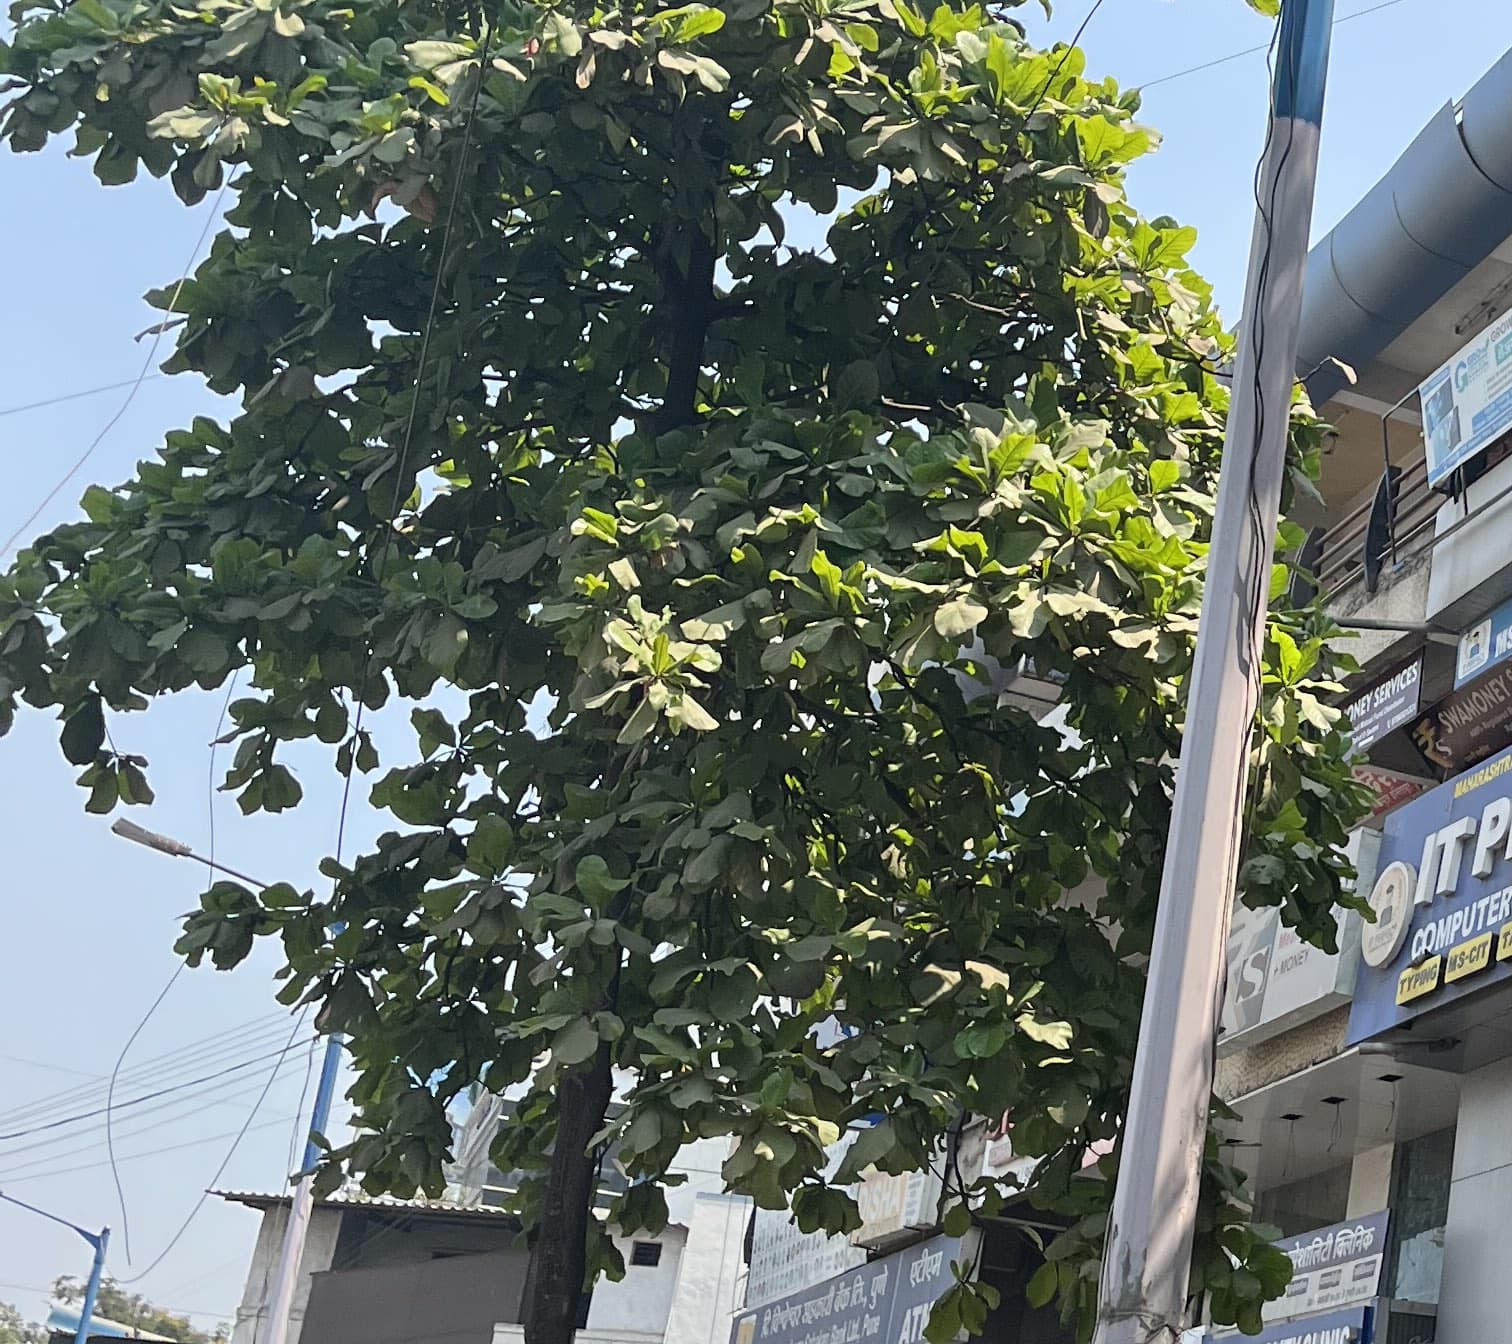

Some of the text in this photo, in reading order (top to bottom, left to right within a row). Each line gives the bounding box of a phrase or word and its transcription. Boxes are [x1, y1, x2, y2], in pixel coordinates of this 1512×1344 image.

[1374, 660, 1419, 708] SERVICES
[1438, 677, 1511, 734] SWAMONEY
[1413, 815, 1478, 907] IT
[1411, 887, 1512, 958] COMPUTER
[1399, 963, 1439, 994] TYPING
[1447, 940, 1490, 974] MS-CIT
[1333, 1225, 1376, 1262] क्लिनिक
